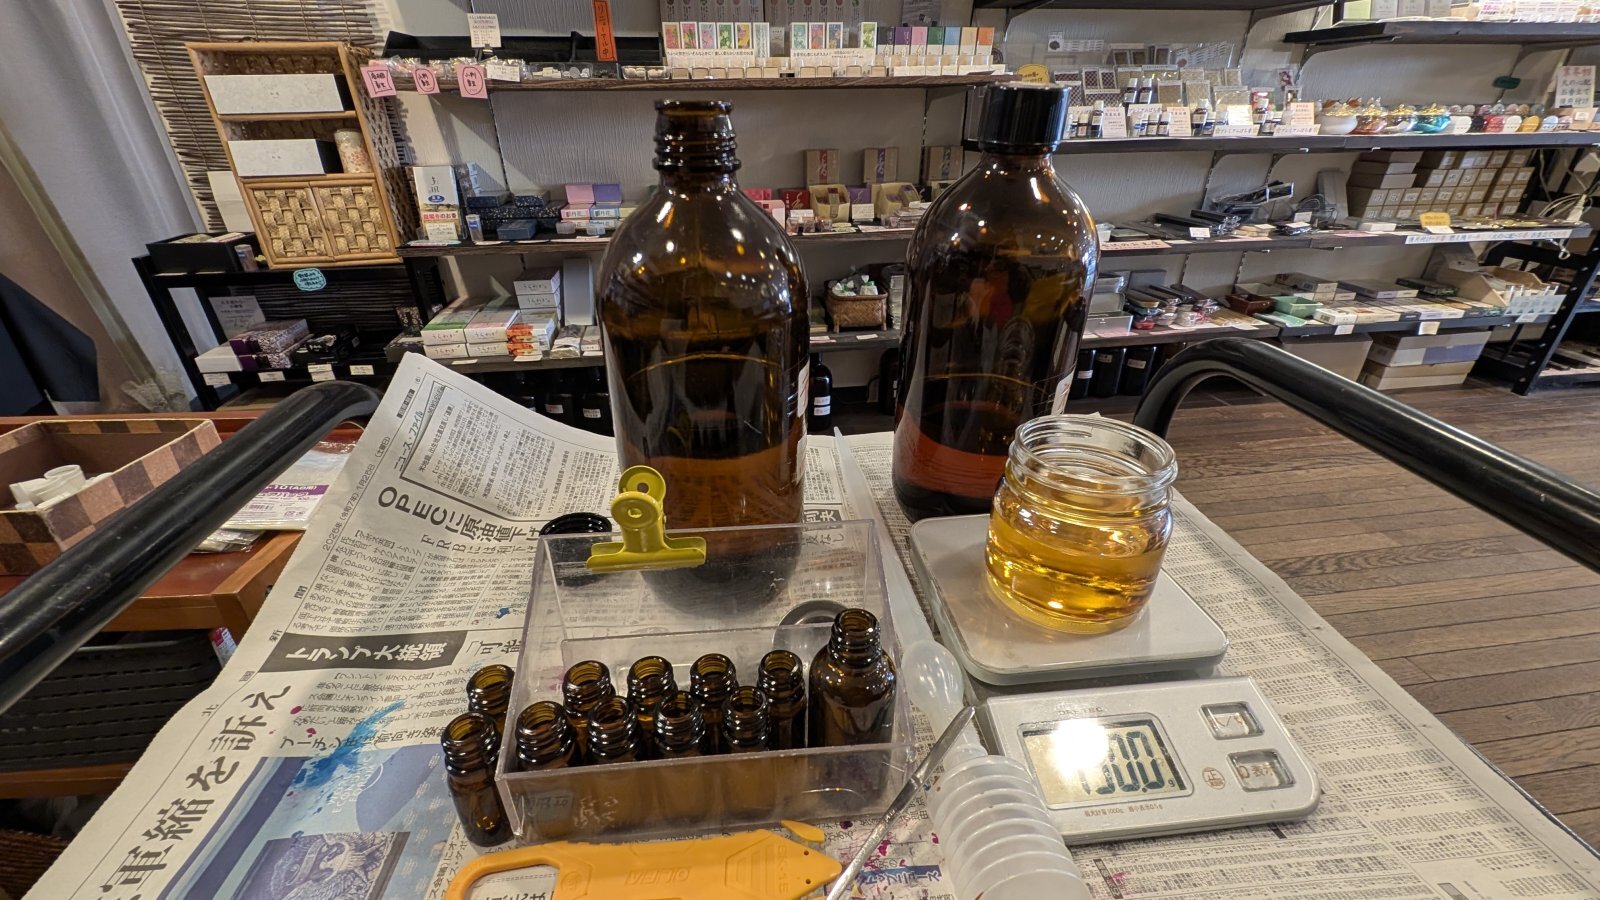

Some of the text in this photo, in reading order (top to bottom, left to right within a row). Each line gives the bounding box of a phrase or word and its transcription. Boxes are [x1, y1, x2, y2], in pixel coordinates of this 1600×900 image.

[285, 642, 447, 662] トランプ大統領
[97, 685, 291, 900] 軍縮を訴え
[625, 867, 691, 887] OLFA
[866, 870, 940, 886] トップニュース
